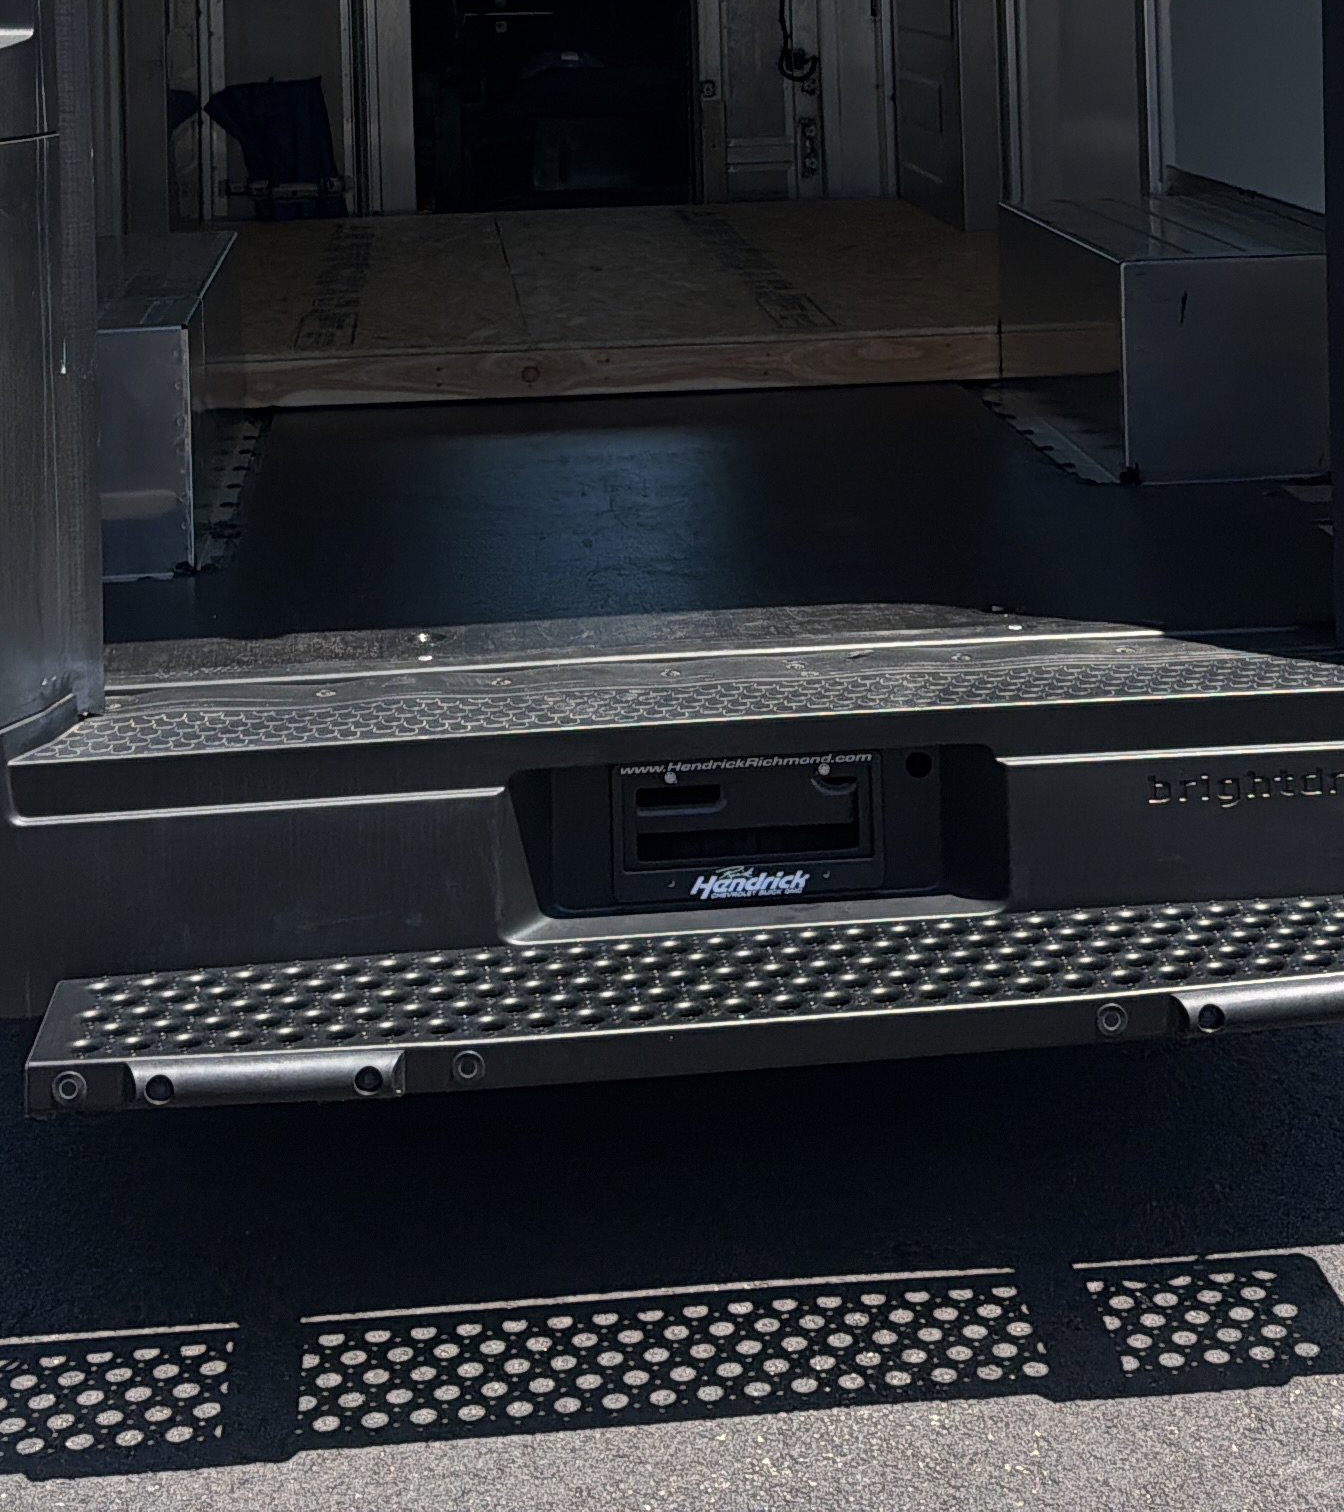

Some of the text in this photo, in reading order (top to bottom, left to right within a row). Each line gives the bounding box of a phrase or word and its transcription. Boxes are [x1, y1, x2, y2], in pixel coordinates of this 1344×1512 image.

[620, 753, 872, 775] www.HendrickRichmond.com
[690, 870, 810, 900] Hendrick
[710, 890, 757, 900] CHEVROLET
